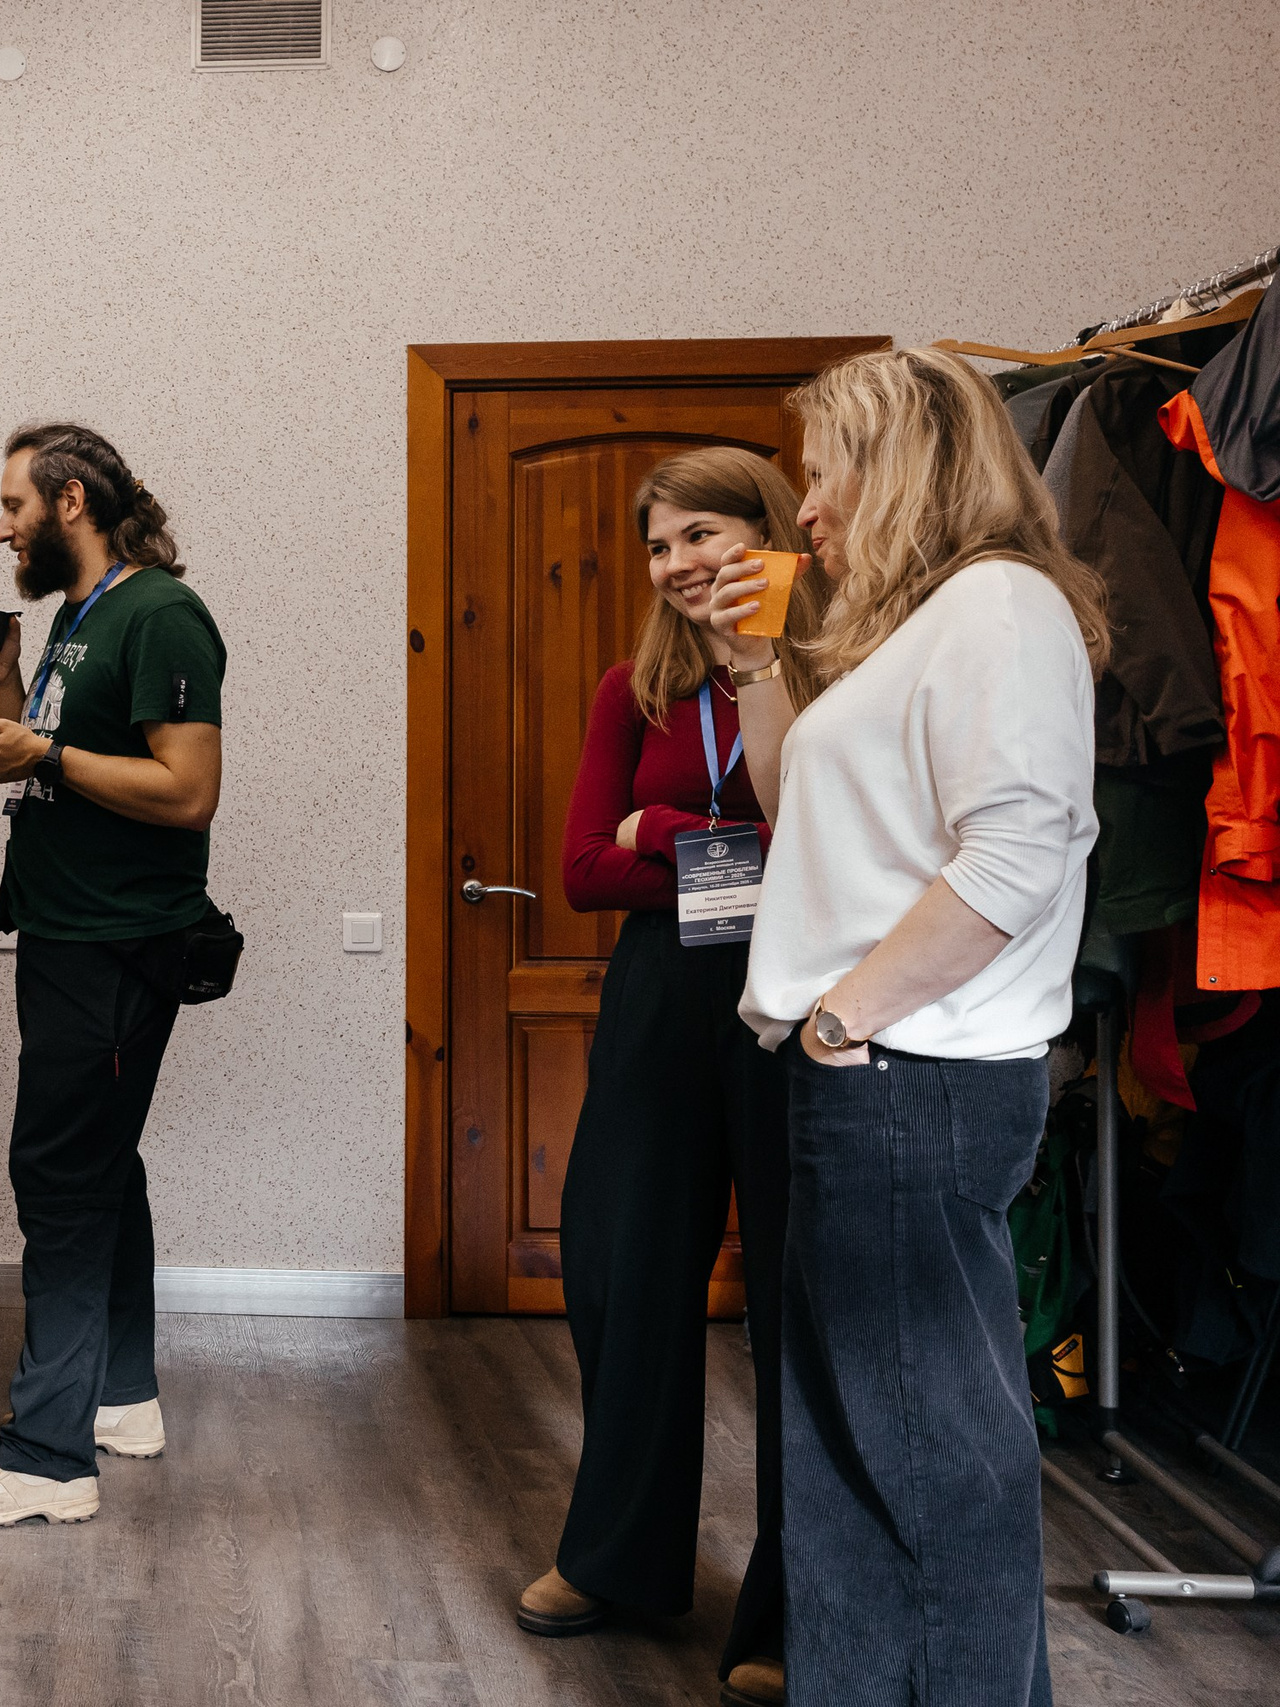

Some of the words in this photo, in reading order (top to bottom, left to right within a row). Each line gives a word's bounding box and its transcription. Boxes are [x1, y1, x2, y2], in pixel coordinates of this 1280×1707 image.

[704, 894, 737, 902] Никитенко
[685, 906, 718, 914] Екатерина
[719, 902, 758, 911] Дмитриевна
